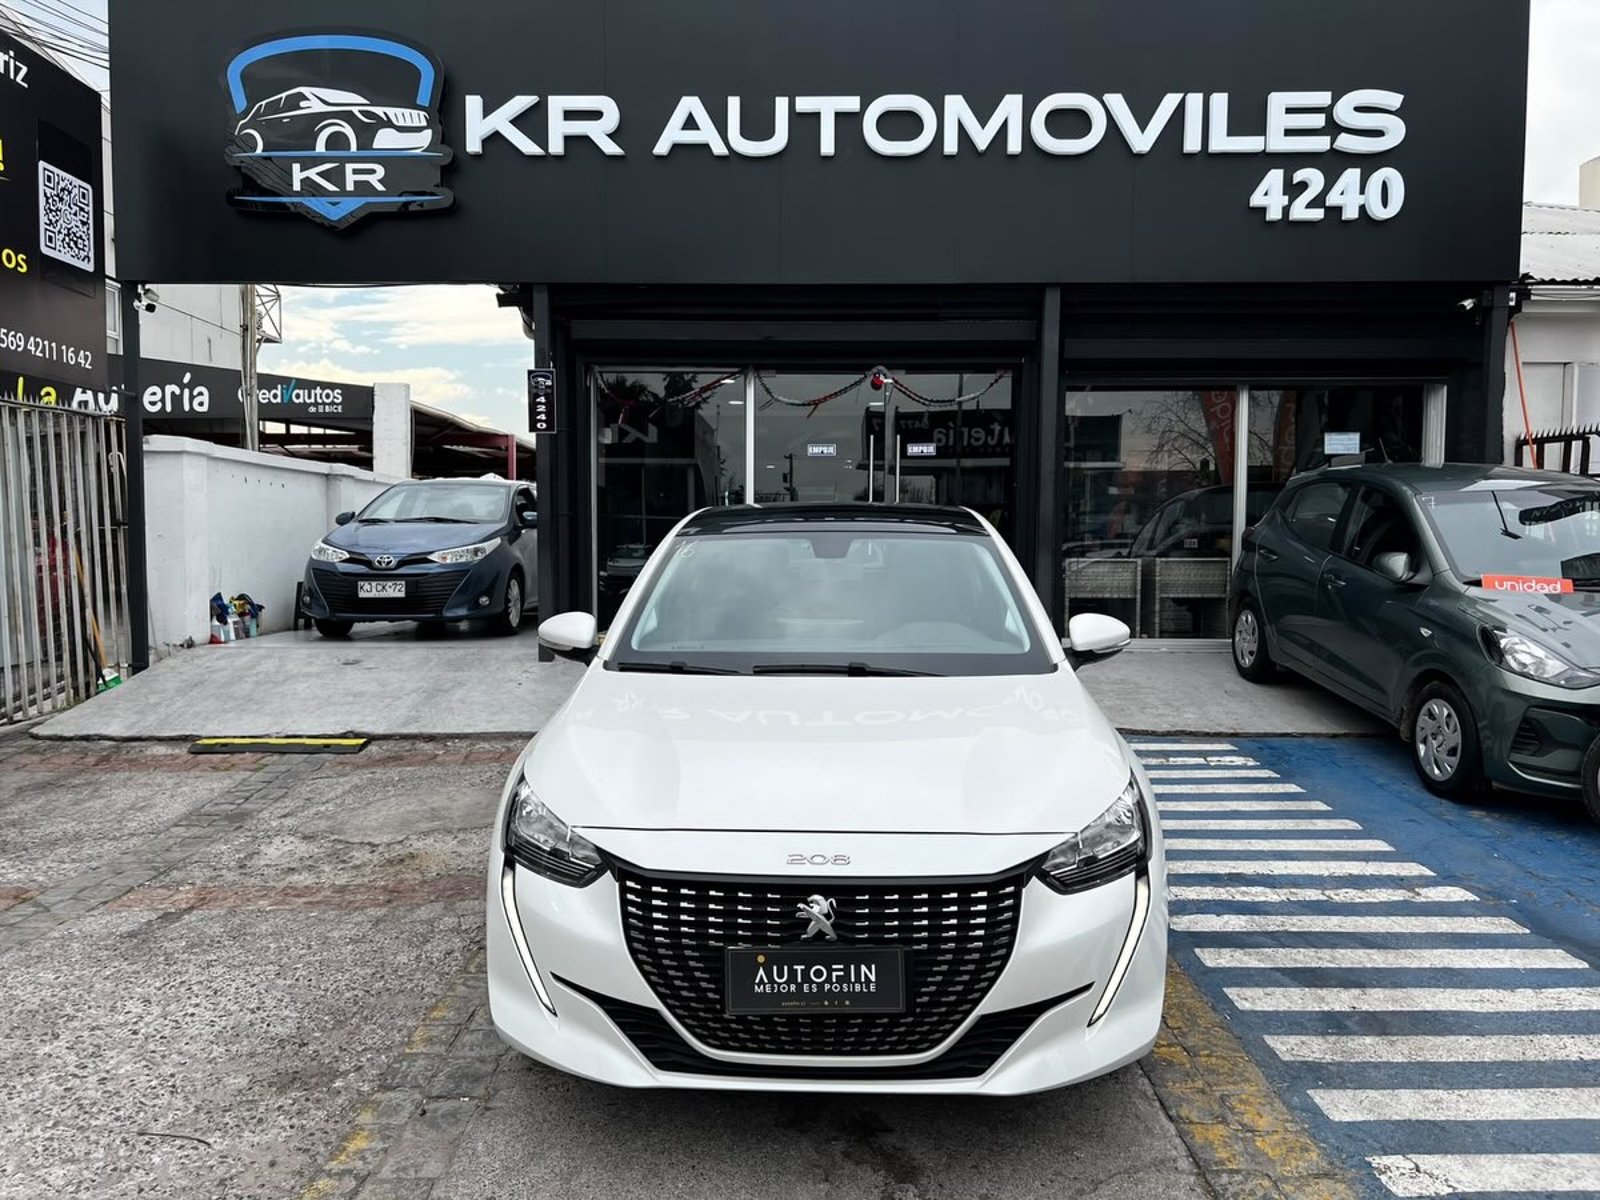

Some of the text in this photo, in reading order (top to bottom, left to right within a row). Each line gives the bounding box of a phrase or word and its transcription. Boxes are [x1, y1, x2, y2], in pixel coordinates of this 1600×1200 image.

[0, 50, 28, 88] riz
[465, 89, 1406, 157] KR AUTOMOVILES
[292, 163, 386, 192] KR
[1250, 167, 1406, 222] 4240
[0, 328, 92, 369] 569 4211 16 42
[72, 370, 210, 414] Auería
[536, 396, 547, 429] 4240
[1494, 579, 1561, 593] unidad
[786, 853, 851, 865] 208
[754, 983, 877, 993] MEJOR ES POSIBLE
[755, 960, 877, 983] AUTOFIN
